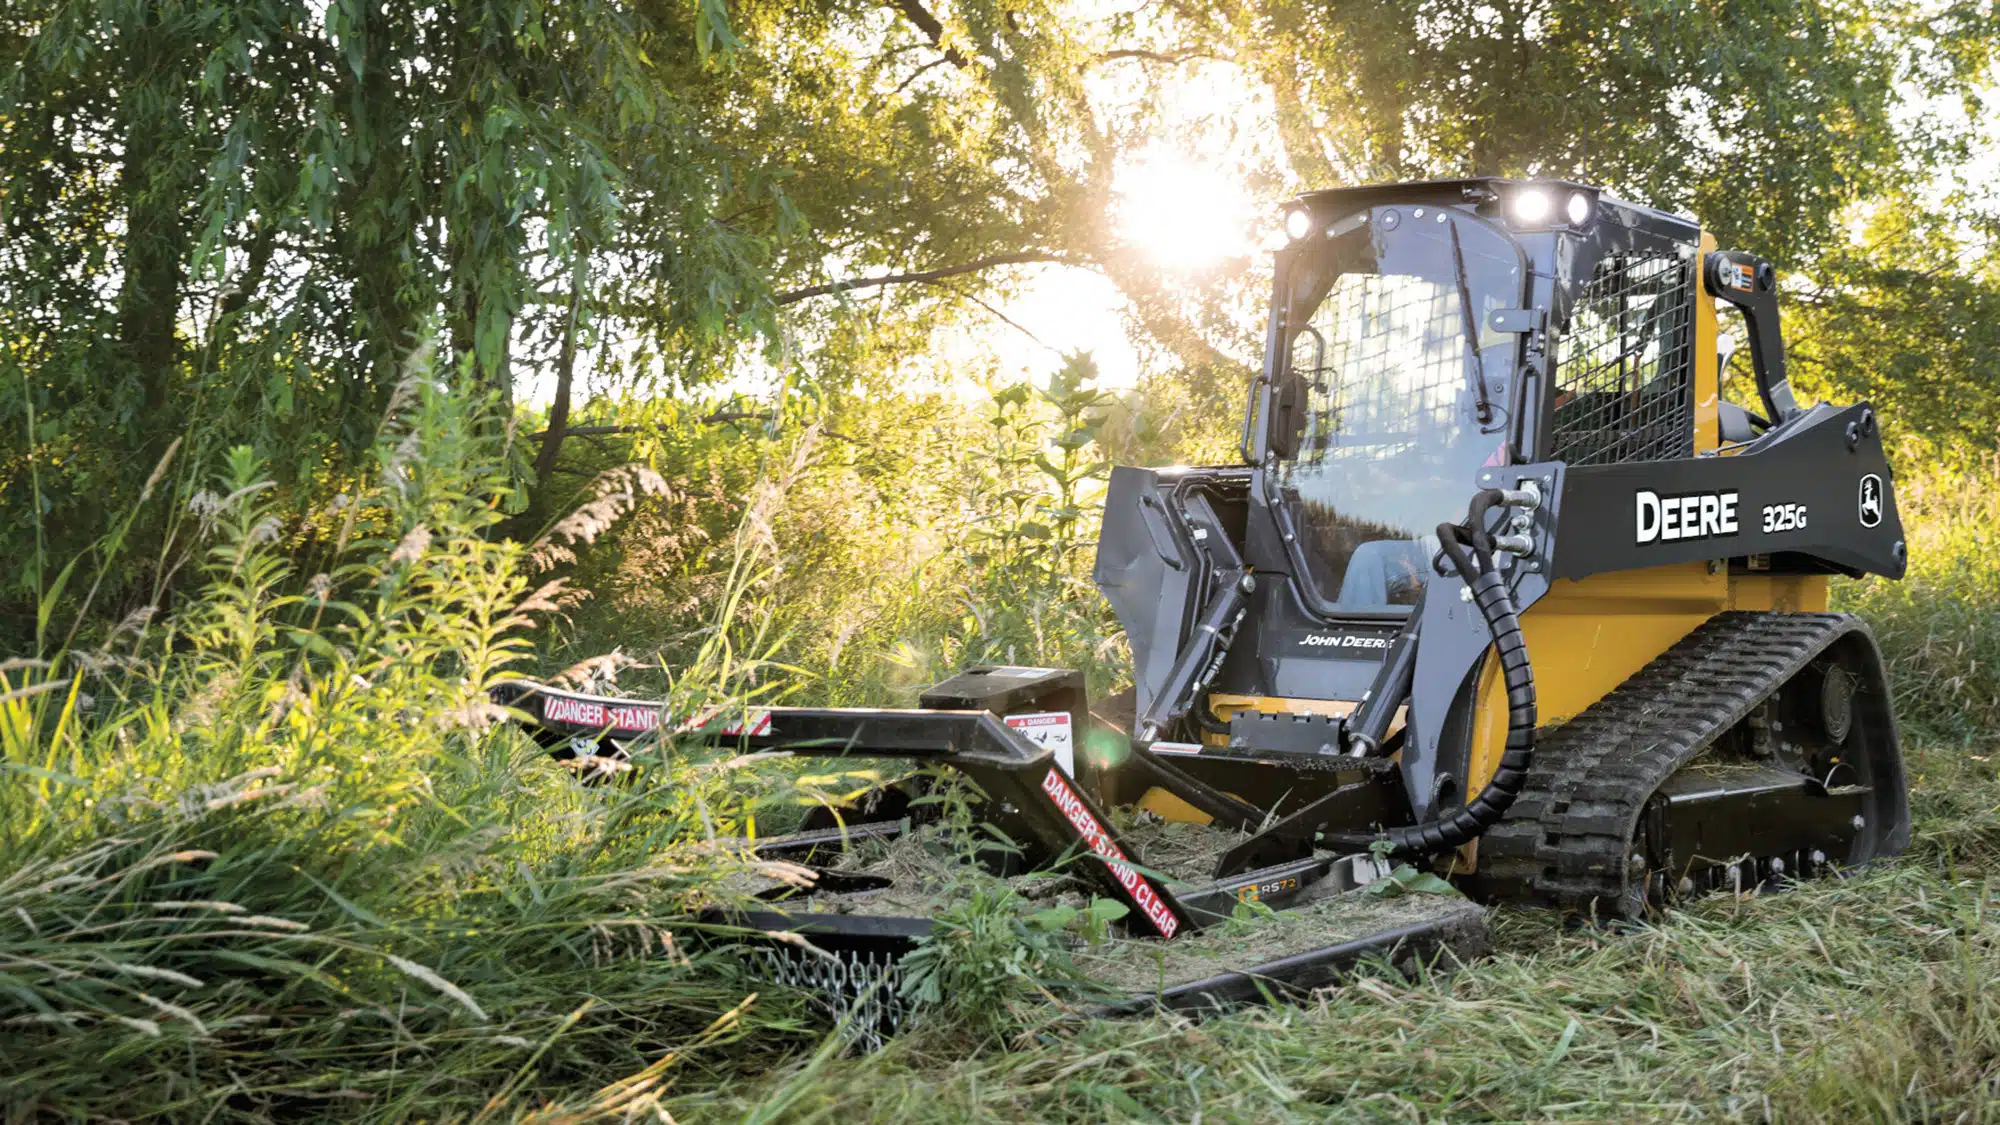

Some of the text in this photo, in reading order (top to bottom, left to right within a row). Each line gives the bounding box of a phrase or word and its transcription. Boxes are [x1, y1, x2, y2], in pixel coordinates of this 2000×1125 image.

[1636, 491, 1738, 543] DEERE
[1762, 503, 1807, 533] 325G
[1299, 634, 1341, 646] JOHN
[556, 701, 604, 726] DANGER
[1027, 717, 1057, 726] DANGER
[1043, 769, 1099, 841] DANGER
[1136, 884, 1177, 938] CLEAR
